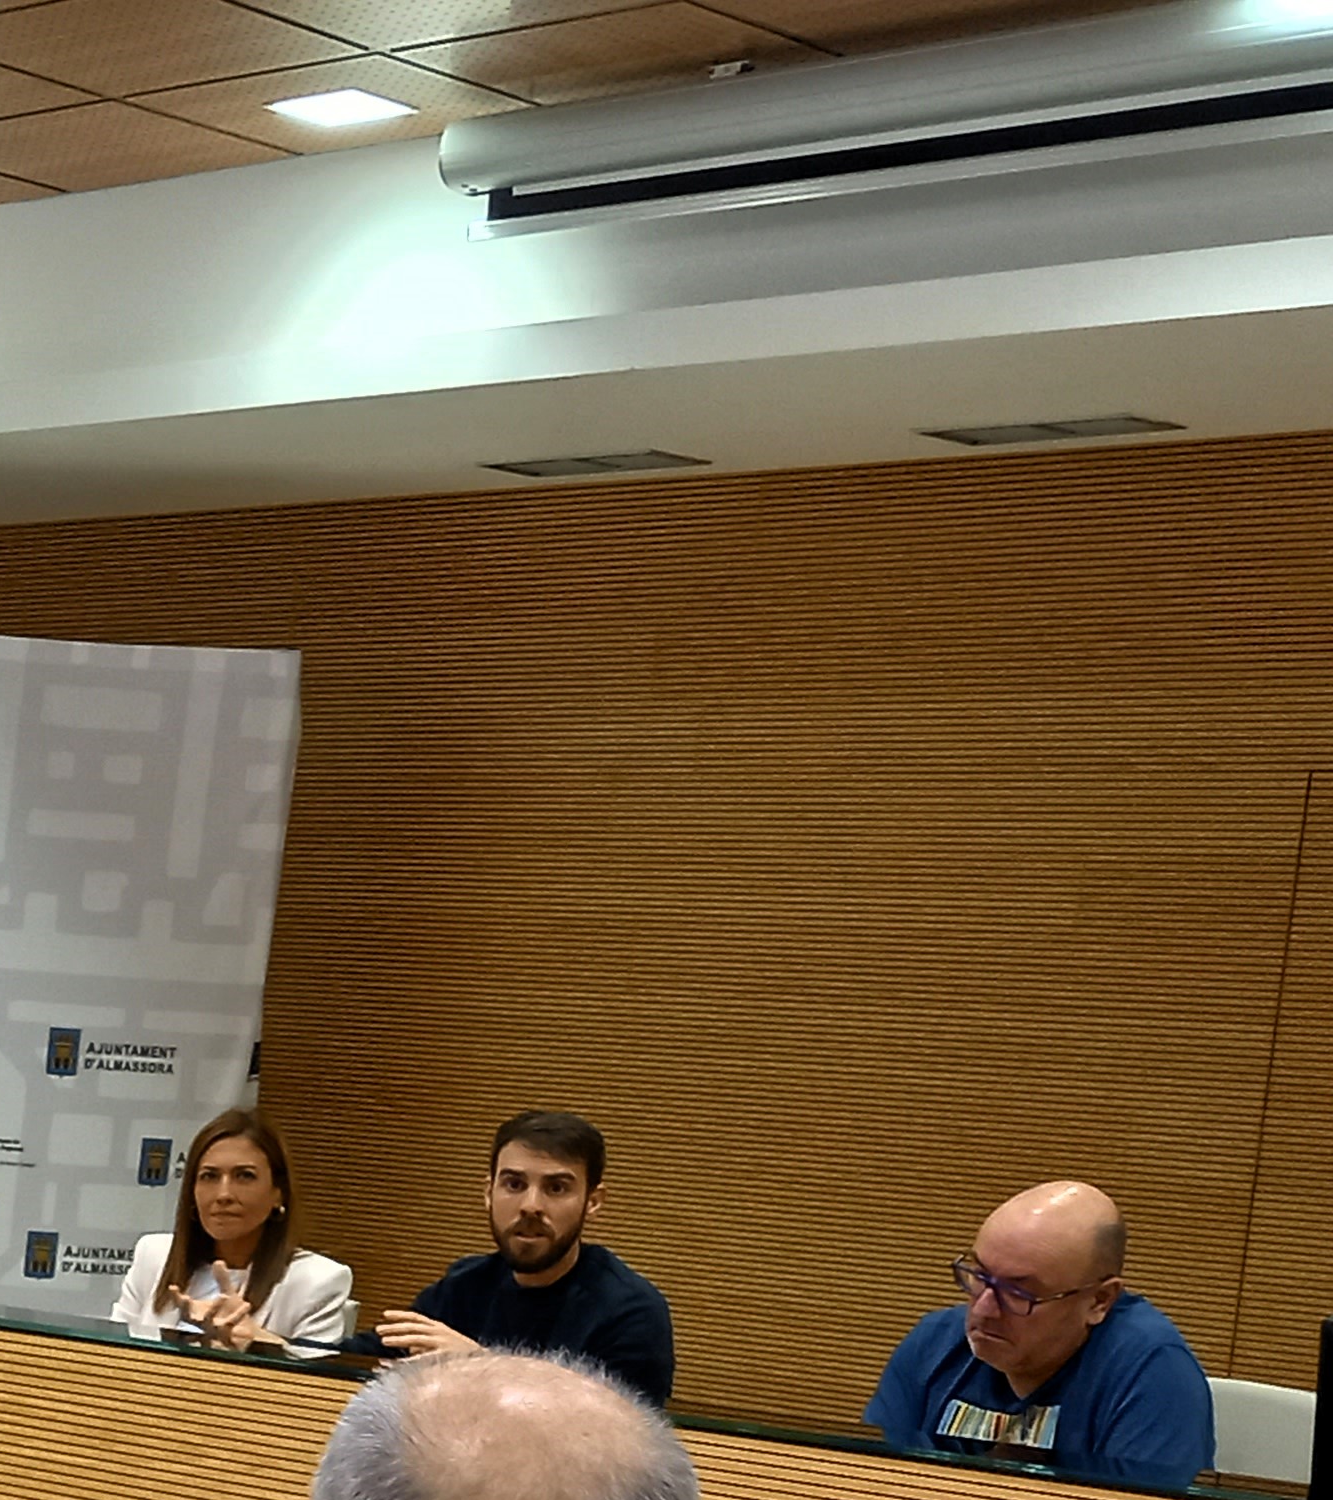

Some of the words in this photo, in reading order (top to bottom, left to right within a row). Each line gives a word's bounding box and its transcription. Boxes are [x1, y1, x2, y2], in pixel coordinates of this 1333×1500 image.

[86, 1043, 177, 1058] AJUNTAMENT
[85, 1059, 173, 1073] D'ALMASSORA
[63, 1246, 134, 1261] AJUNTAME
